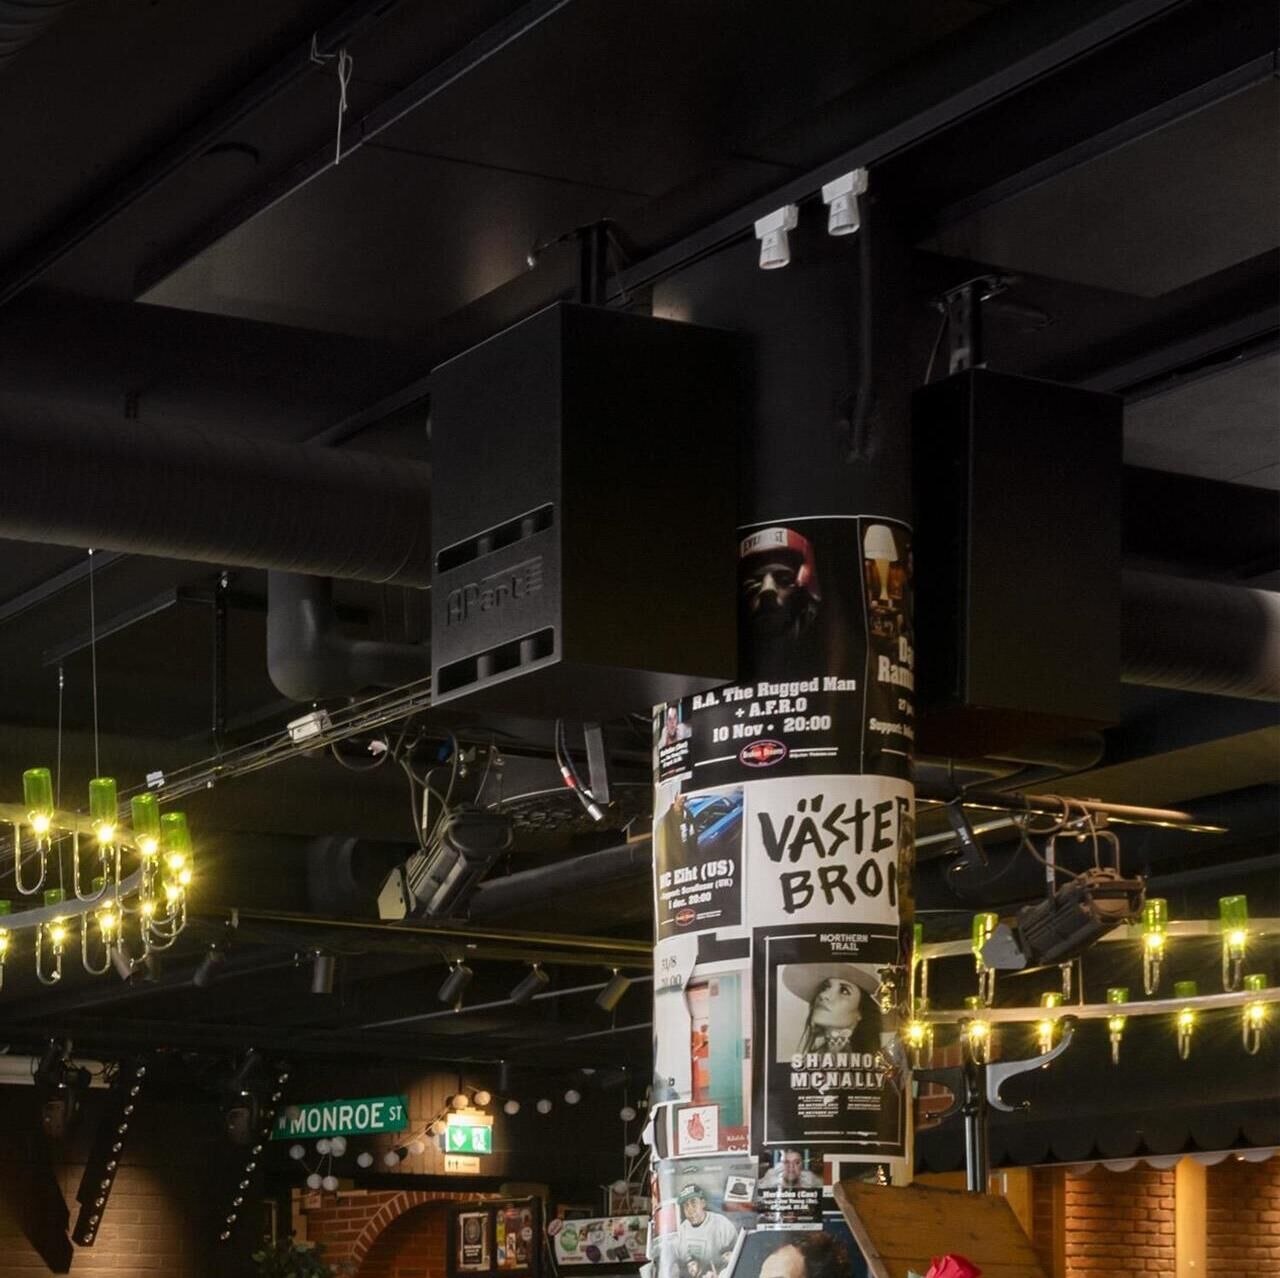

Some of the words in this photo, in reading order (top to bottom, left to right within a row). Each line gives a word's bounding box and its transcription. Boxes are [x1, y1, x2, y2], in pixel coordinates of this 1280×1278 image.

[692, 692, 719, 710] R.A.
[723, 686, 753, 703] The
[757, 678, 819, 697] Rugged
[823, 676, 856, 692] Man
[749, 697, 807, 717] A.F.R.O
[713, 726, 729, 743] 10
[732, 723, 764, 739] Nov
[783, 715, 831, 733] 20:00
[701, 858, 735, 880] (US)
[820, 934, 869, 943] NORTHERN
[831, 942, 859, 951] TRAIL
[290, 1102, 384, 1134] MONROE
[389, 1105, 403, 1121] ST
